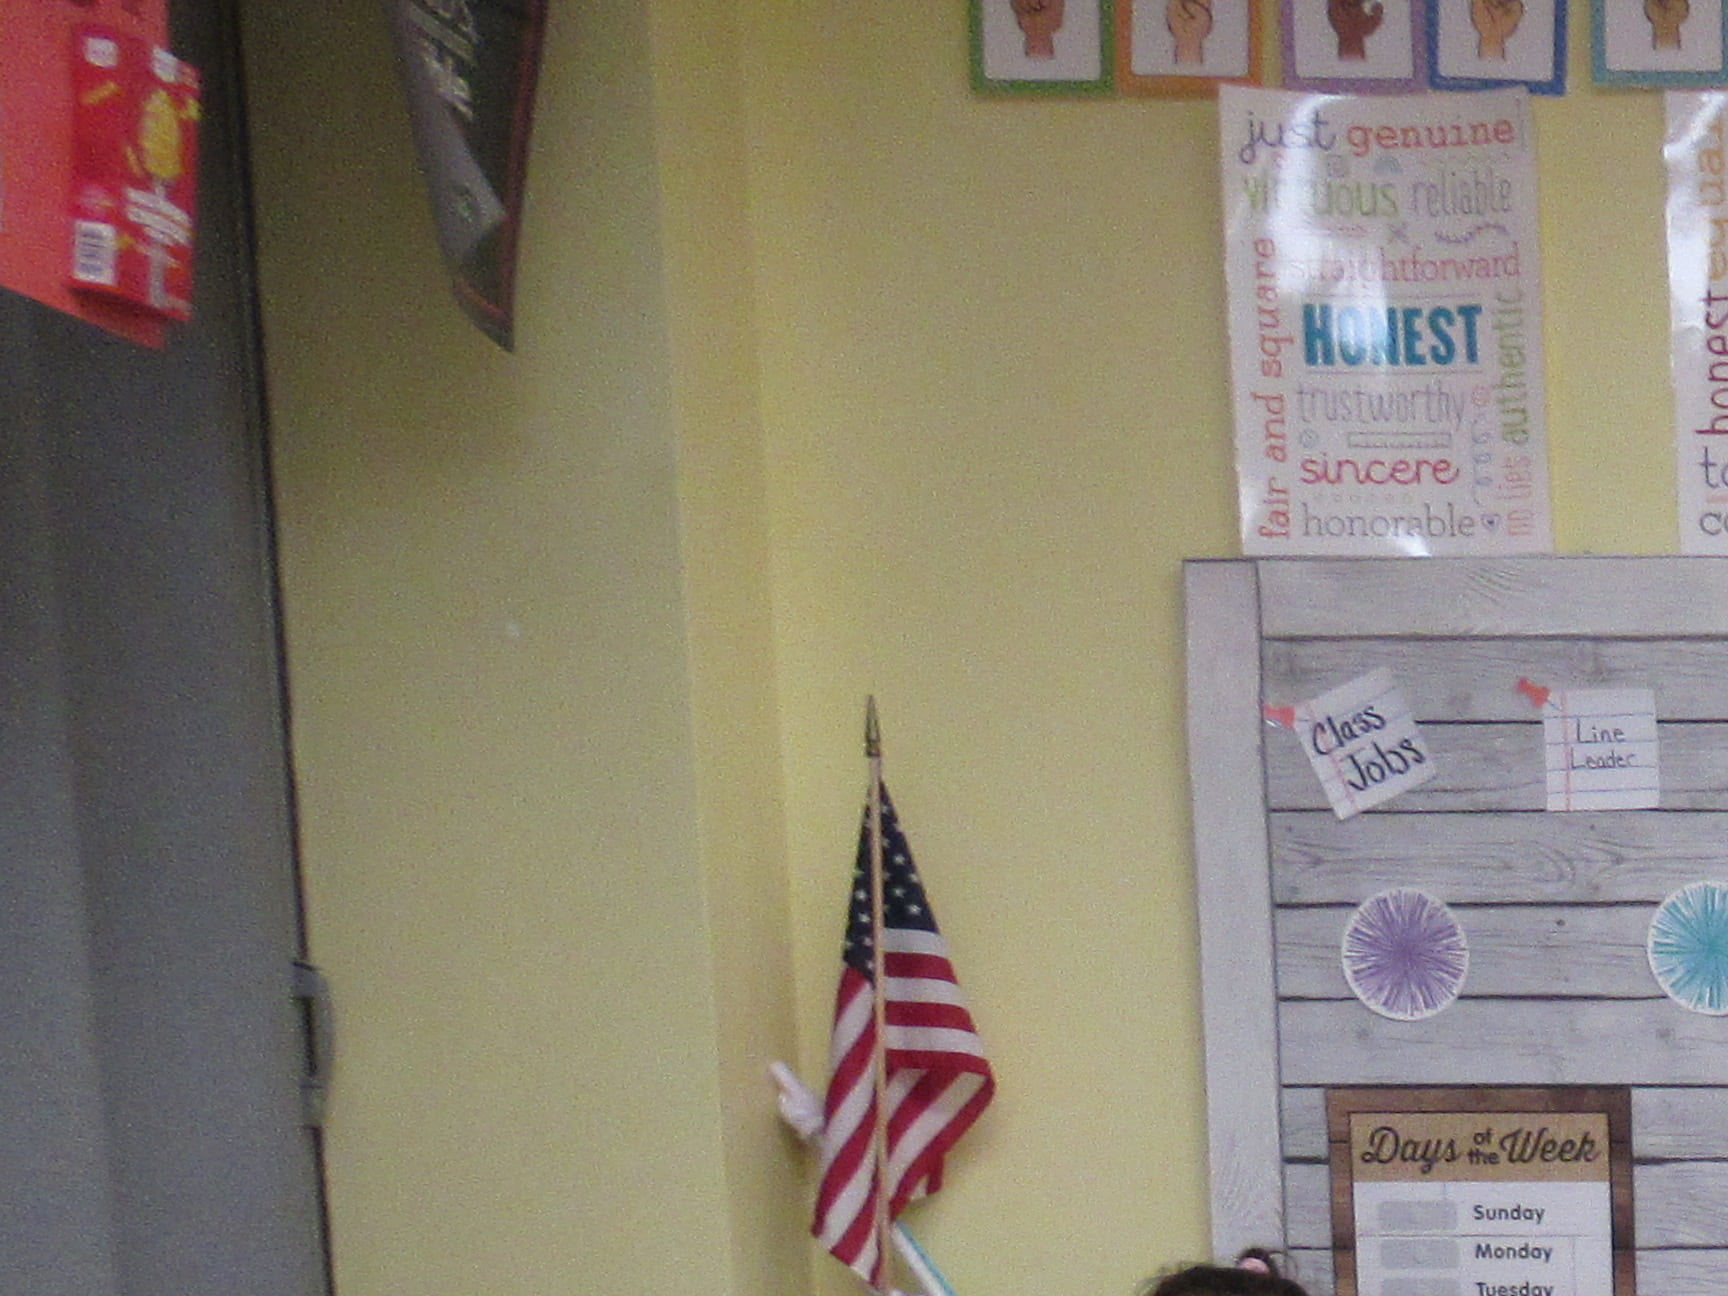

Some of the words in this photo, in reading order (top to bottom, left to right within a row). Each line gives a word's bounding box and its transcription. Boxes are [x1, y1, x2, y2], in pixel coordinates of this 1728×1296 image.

[1346, 116, 1516, 158] genuine
[1412, 170, 1512, 218] reliable
[1256, 240, 1294, 378] square
[1302, 303, 1483, 367] HONEST
[1299, 384, 1465, 424] trustworthy
[1252, 392, 1288, 464] and
[1300, 453, 1460, 486] sincere
[1258, 477, 1292, 542] fair
[1302, 503, 1476, 540] honorable
[1311, 704, 1388, 757] Class
[1576, 718, 1625, 744] Line
[1346, 737, 1427, 792] Jobs
[1571, 746, 1638, 771] Leader
[1360, 1124, 1458, 1175] Days
[1472, 1128, 1495, 1149] of
[1499, 1127, 1597, 1169] Week
[1472, 1204, 1547, 1231] Sunday
[1474, 1243, 1554, 1270] Monday
